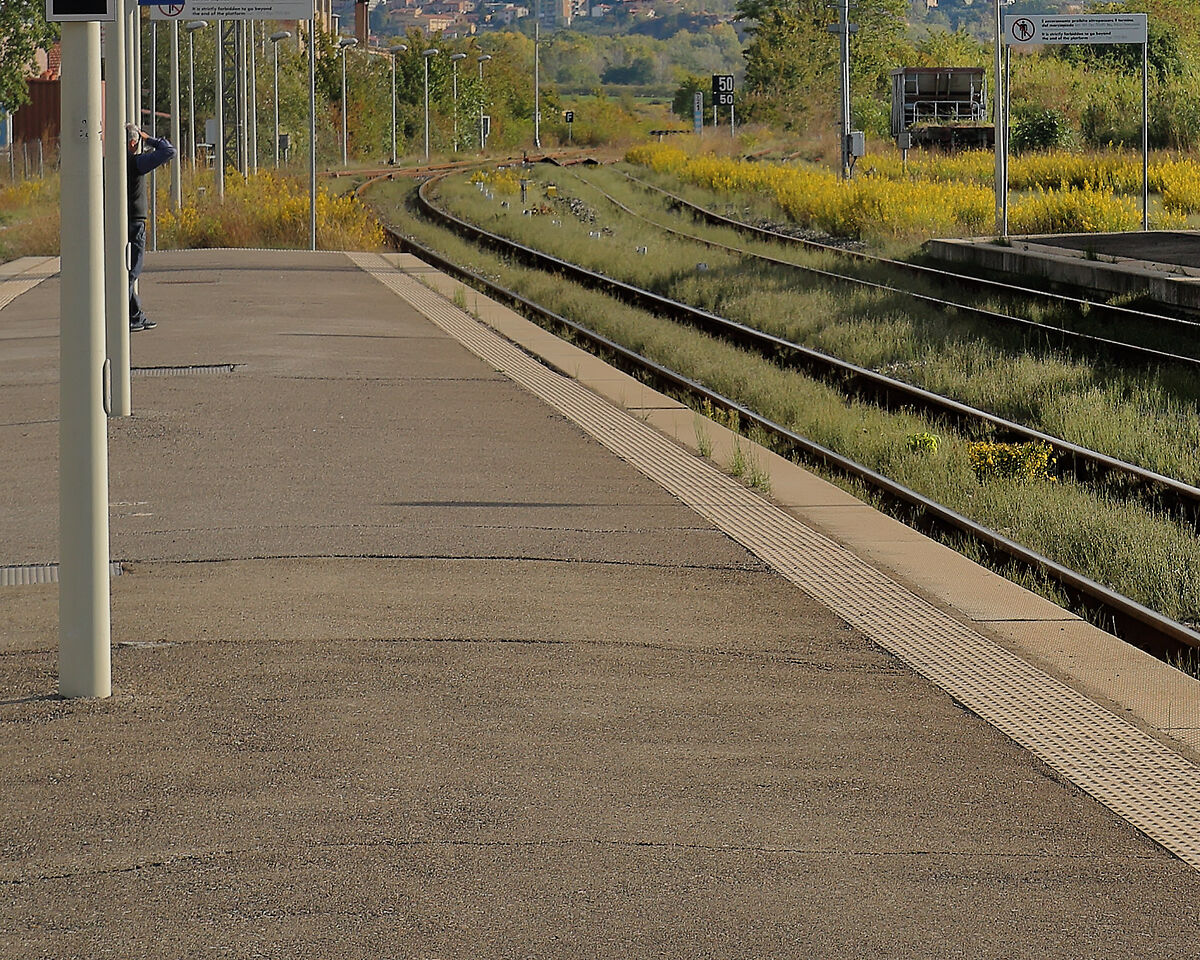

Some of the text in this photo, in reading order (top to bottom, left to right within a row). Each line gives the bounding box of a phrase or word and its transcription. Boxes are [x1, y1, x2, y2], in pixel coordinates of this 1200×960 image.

[718, 76, 733, 91] 50
[719, 94, 733, 104] 50
[567, 112, 573, 122] F
